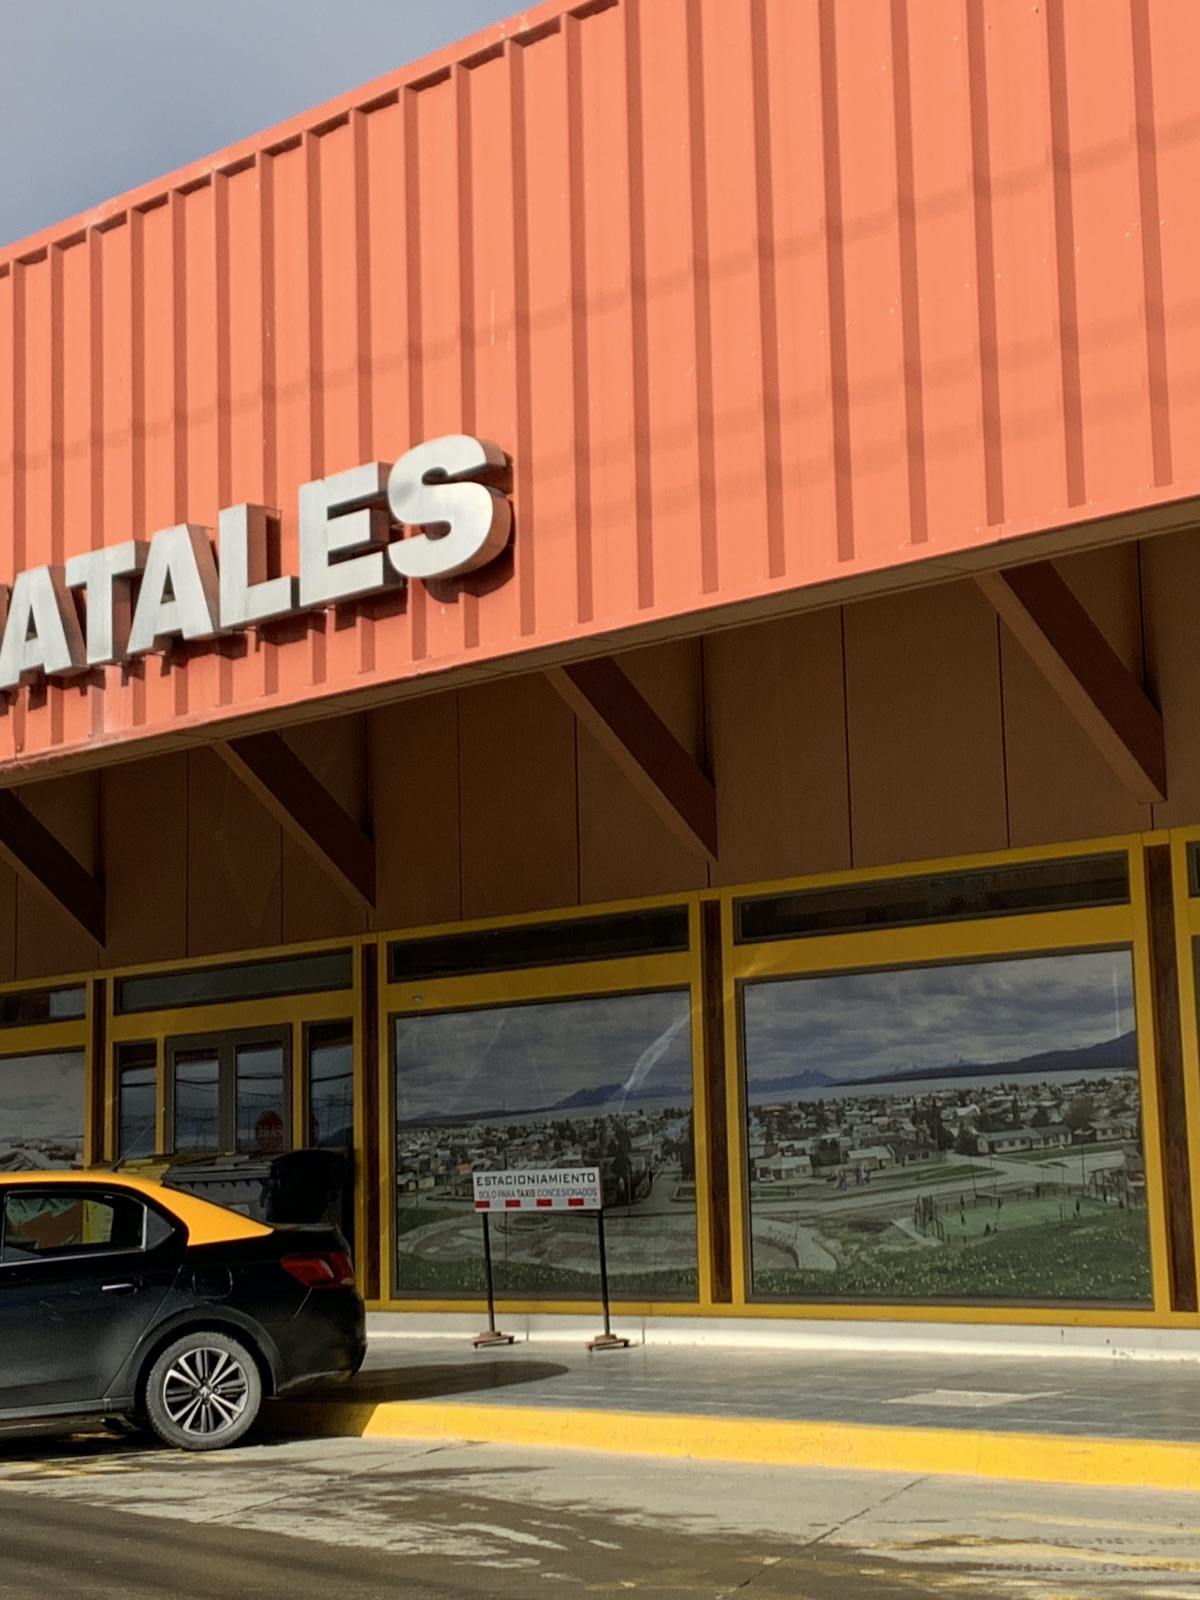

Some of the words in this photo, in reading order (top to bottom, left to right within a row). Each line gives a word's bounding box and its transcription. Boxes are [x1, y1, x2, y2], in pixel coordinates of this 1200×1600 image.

[478, 1189, 497, 1200] SOLO
[498, 1189, 516, 1199] PARA
[516, 1188, 536, 1198] TAXIS
[537, 1187, 598, 1198] CONCESIONADOS
